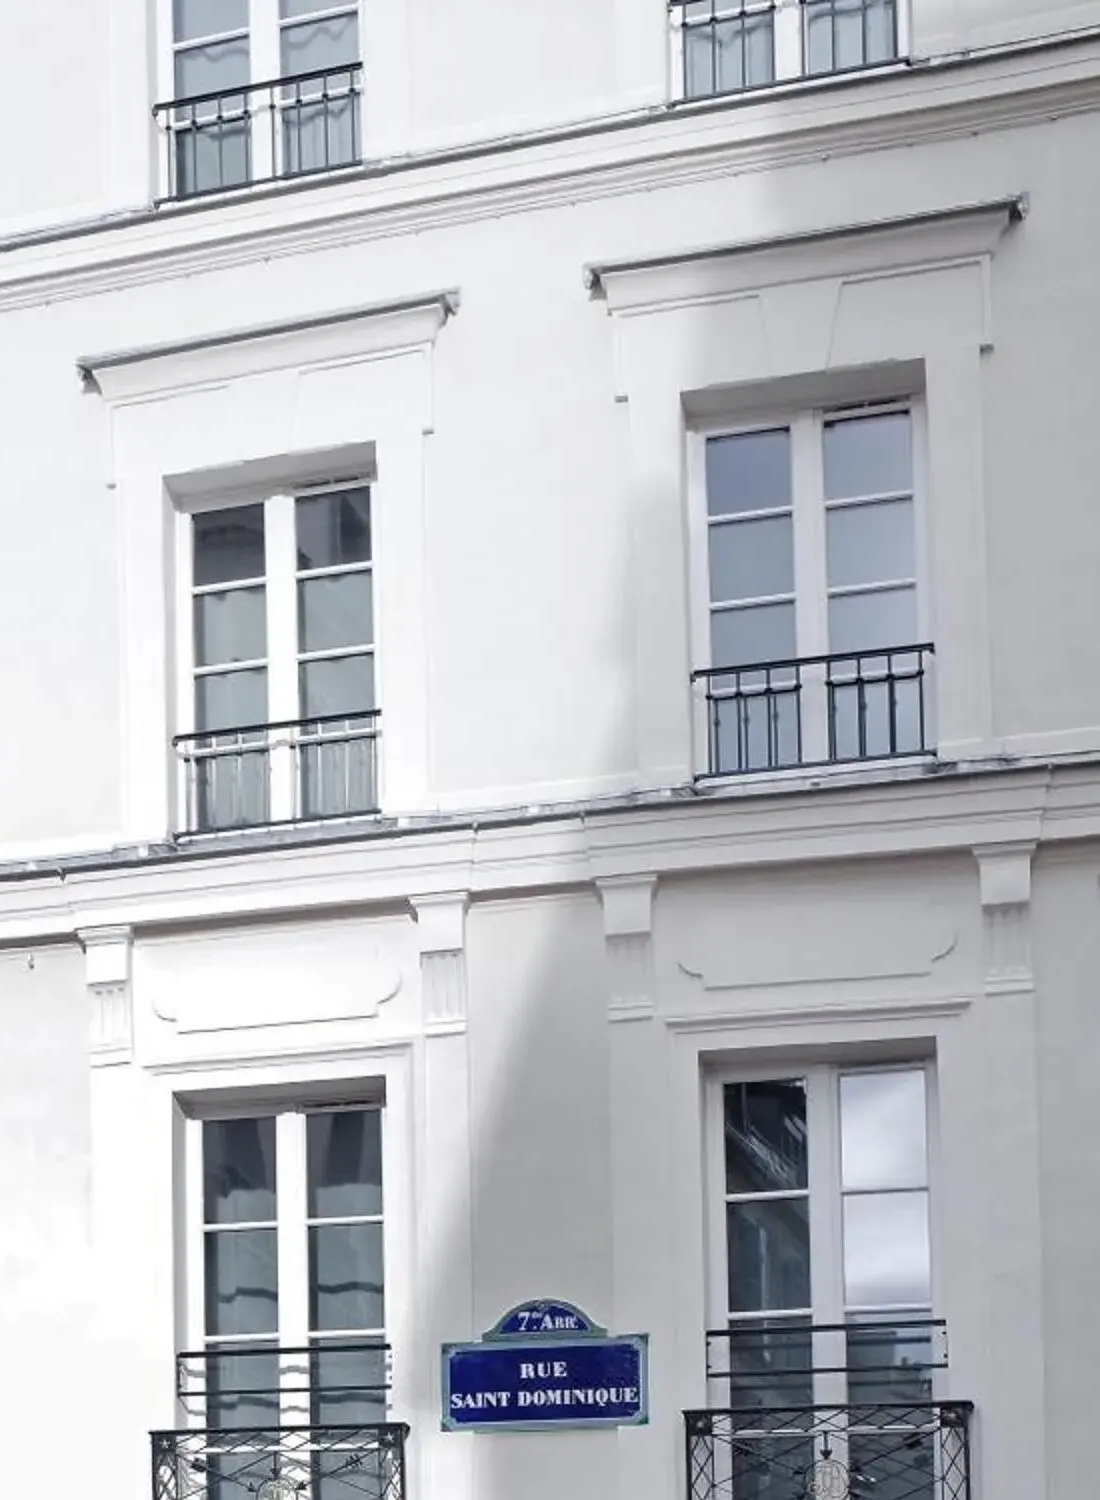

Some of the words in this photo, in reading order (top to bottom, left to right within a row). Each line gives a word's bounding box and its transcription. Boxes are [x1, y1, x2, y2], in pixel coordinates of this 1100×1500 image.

[519, 1361, 568, 1379] RUE
[450, 1391, 511, 1409] SAINT
[516, 1387, 639, 1407] DOMINIQUE
